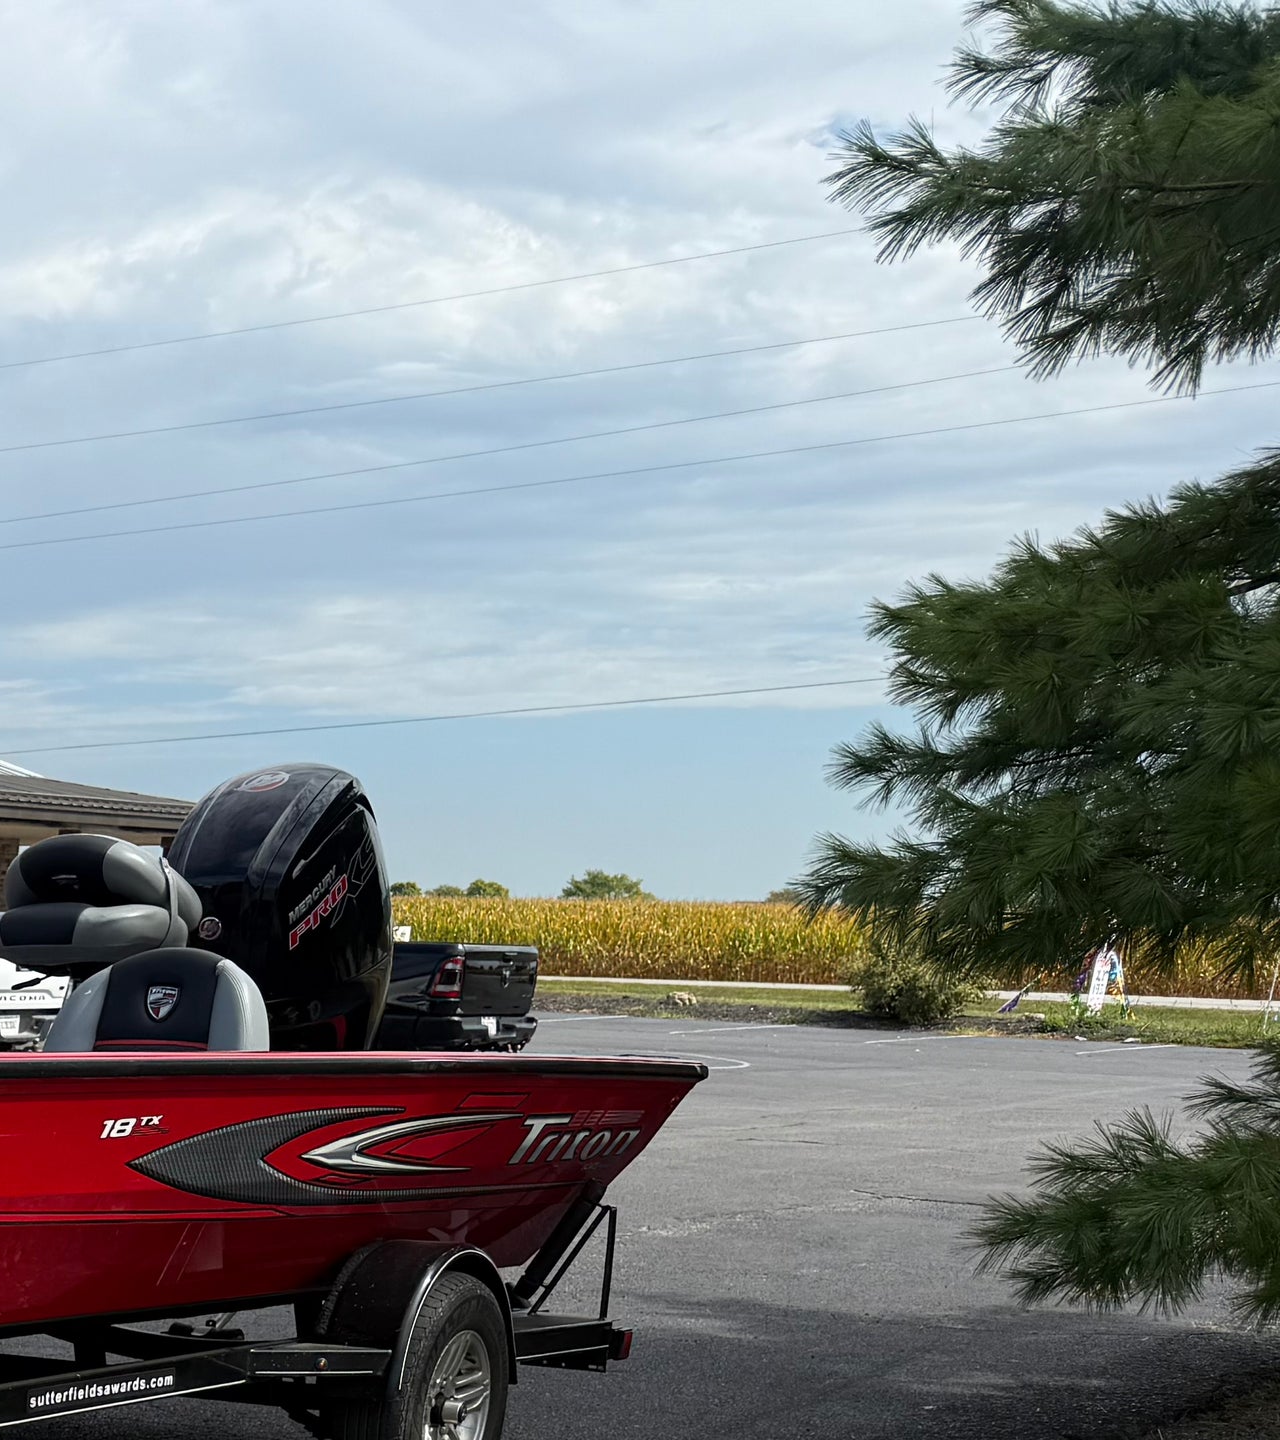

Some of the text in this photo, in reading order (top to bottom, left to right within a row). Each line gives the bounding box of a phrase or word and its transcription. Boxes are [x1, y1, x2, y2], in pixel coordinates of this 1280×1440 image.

[289, 865, 337, 923] MERCURY
[289, 873, 348, 951] PRO
[100, 1115, 164, 1138] 18 TX
[508, 1114, 641, 1165] Triton
[29, 1375, 173, 1409] sutterfieldsawards.com
